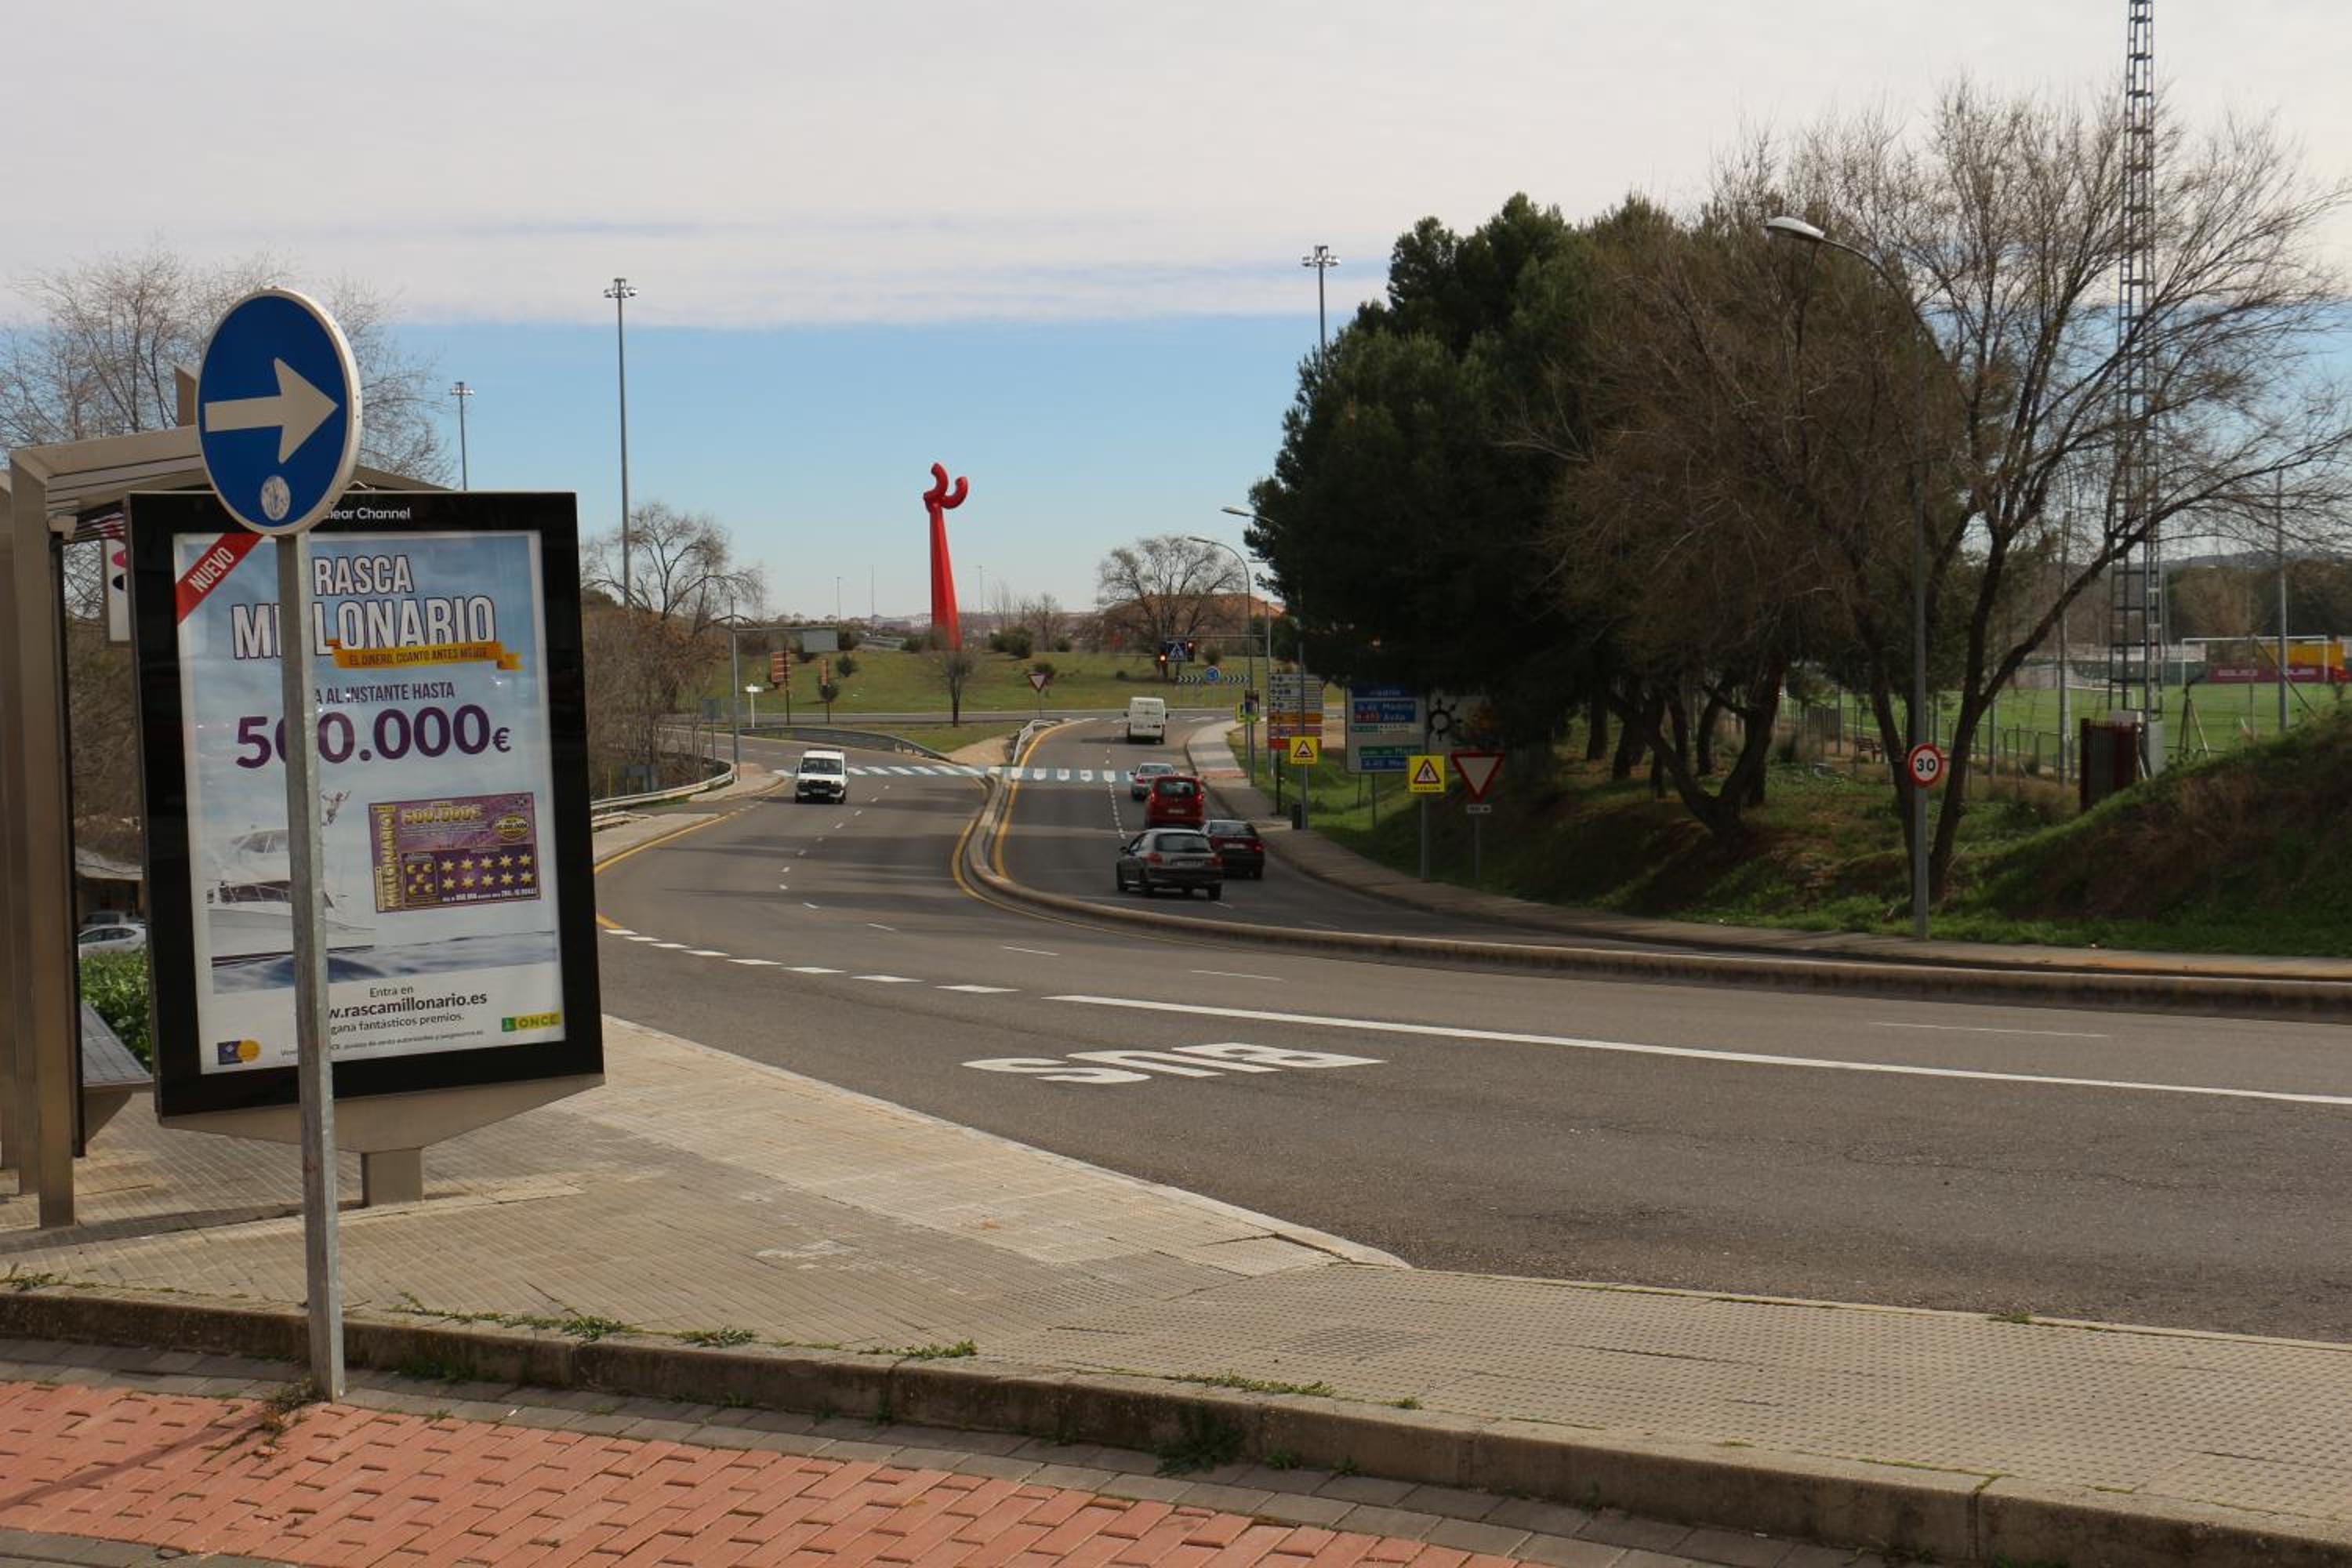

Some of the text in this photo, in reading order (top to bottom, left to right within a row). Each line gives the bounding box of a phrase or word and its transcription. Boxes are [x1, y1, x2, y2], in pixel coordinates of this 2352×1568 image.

[326, 507, 411, 520] lear Channel
[188, 547, 234, 593] NUEVO
[313, 555, 414, 596] RASCA
[232, 596, 496, 659] MILONARIO
[429, 649, 459, 661] ANTES
[327, 687, 343, 704] AL
[347, 683, 409, 703] INSTANTE
[412, 681, 456, 700] HASTA
[236, 704, 511, 768] 50.000€
[1916, 758, 1936, 772] 30
[370, 987, 397, 998] Entra
[328, 992, 487, 1018] w.rascamillonario.es
[330, 1012, 465, 1036] gana fantásticos premios.
[518, 1014, 559, 1028] ONCE
[962, 1042, 1388, 1083] BUS
